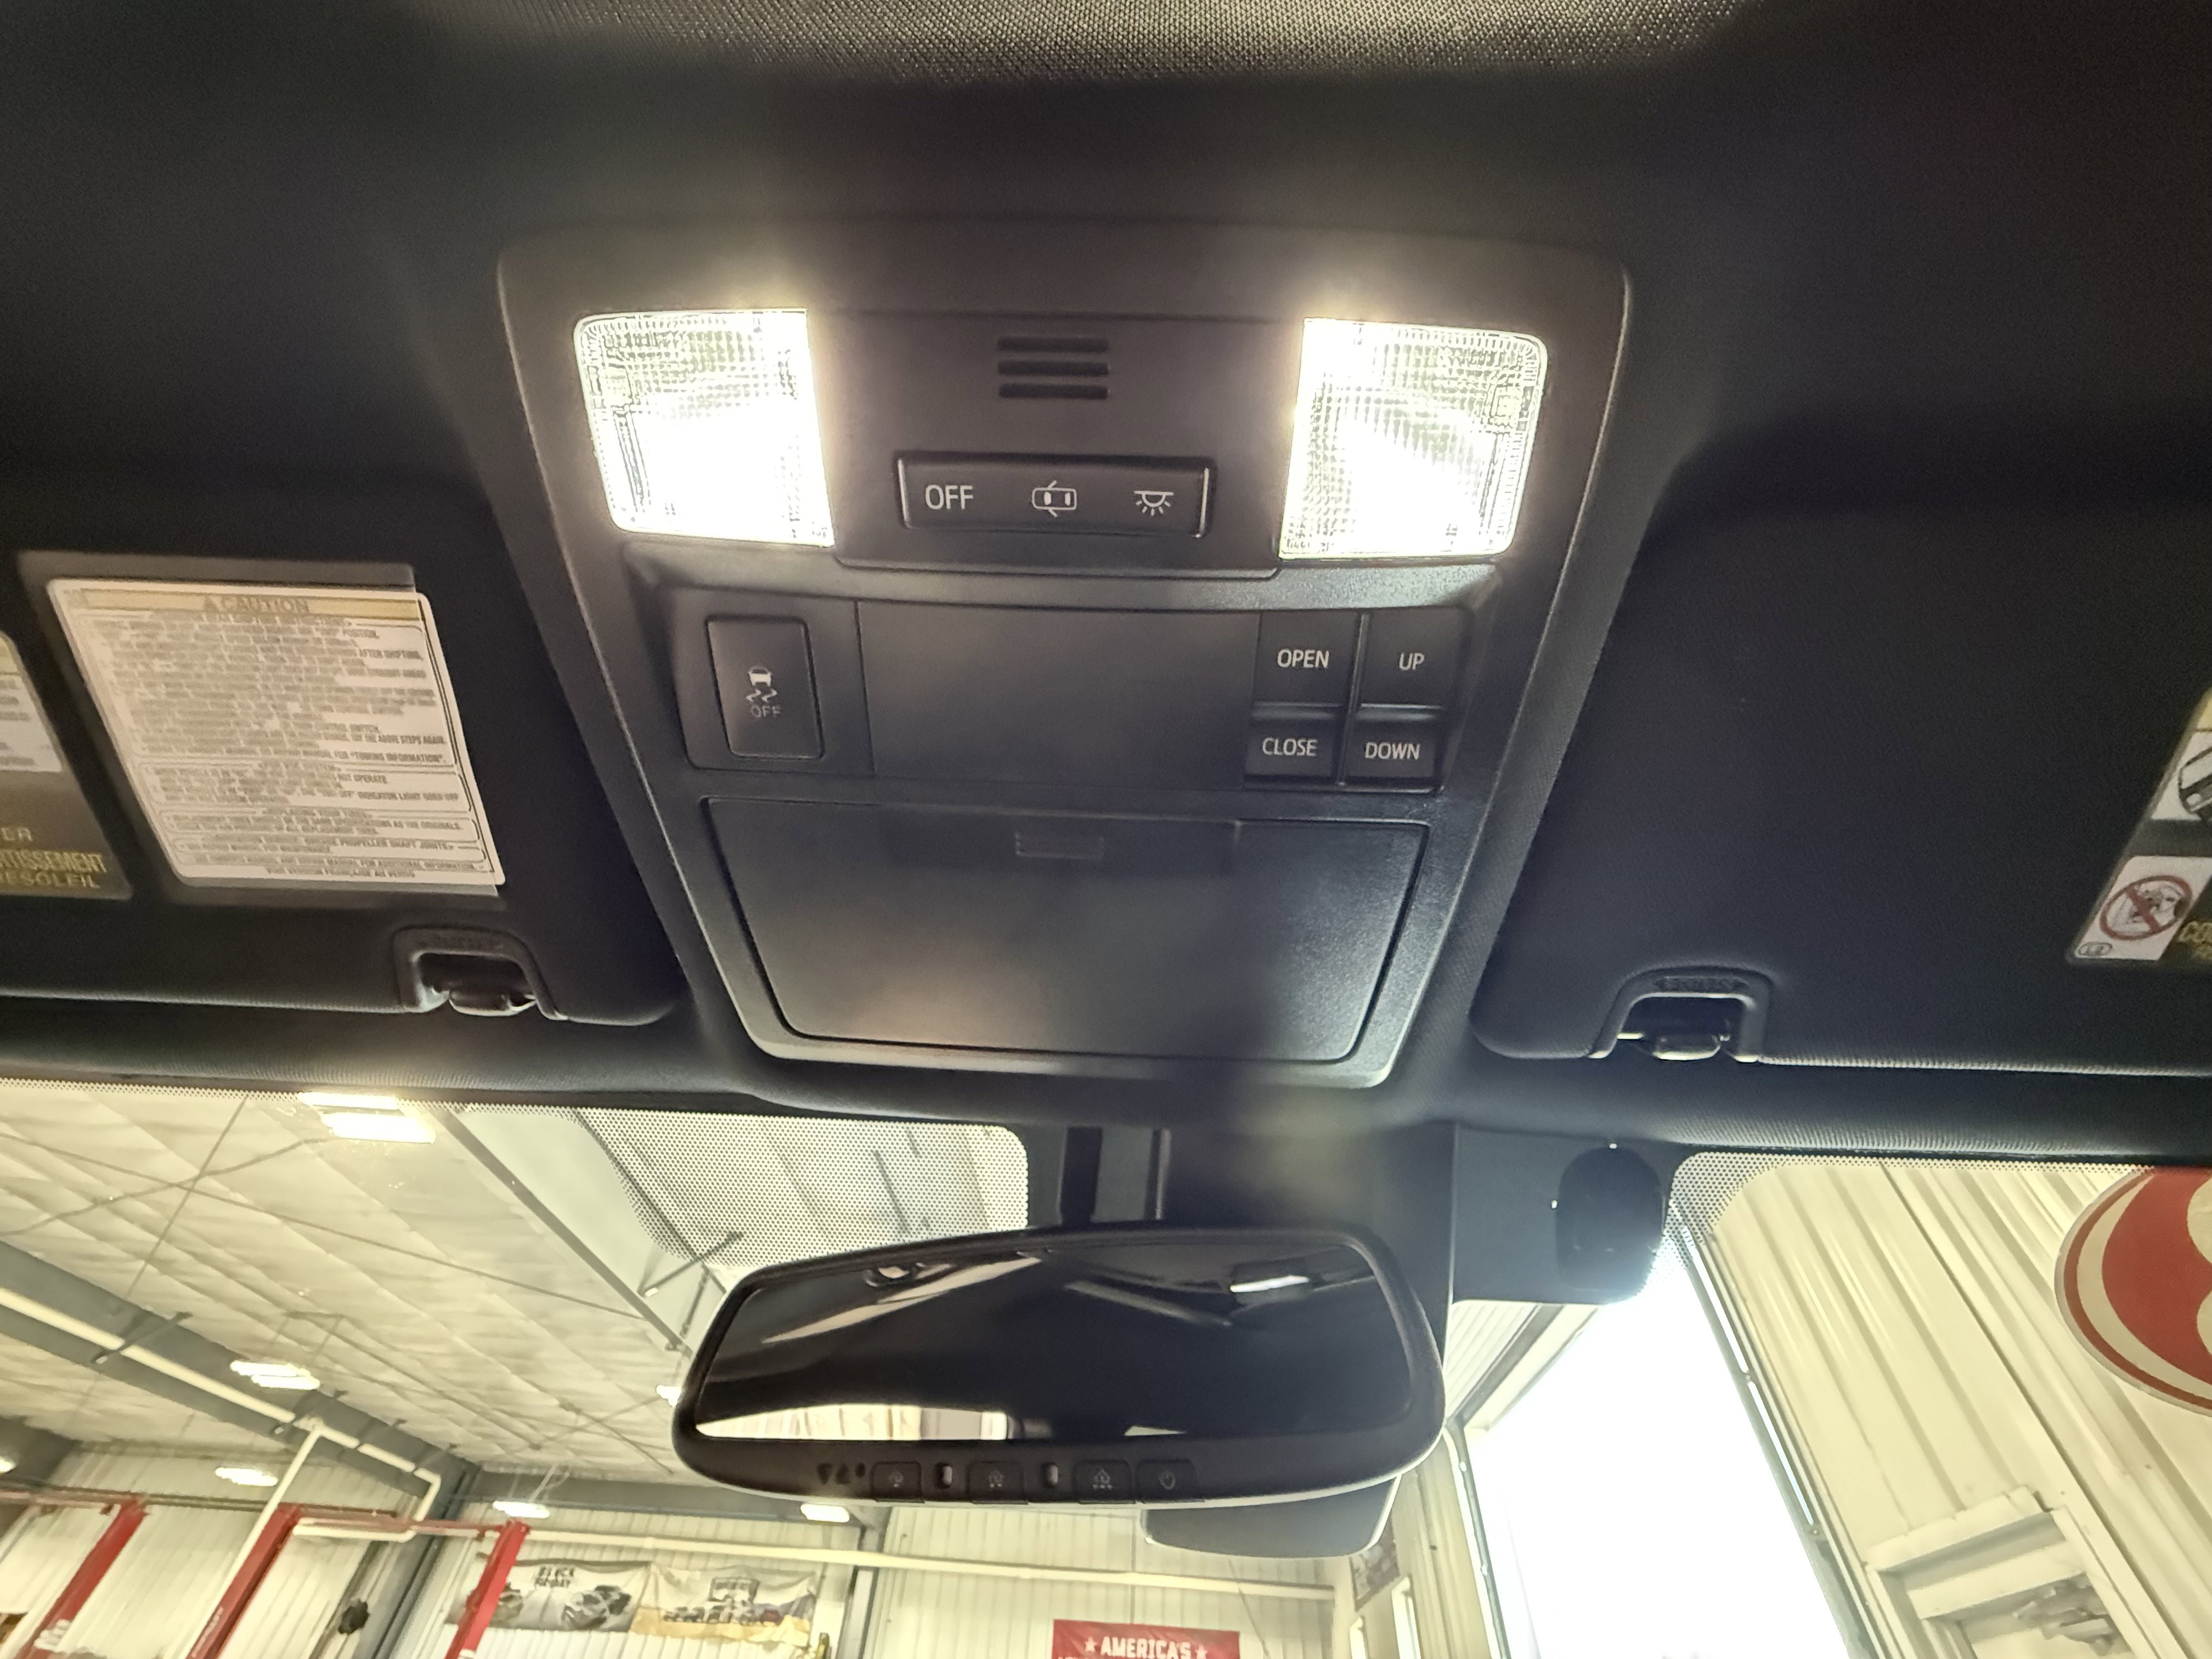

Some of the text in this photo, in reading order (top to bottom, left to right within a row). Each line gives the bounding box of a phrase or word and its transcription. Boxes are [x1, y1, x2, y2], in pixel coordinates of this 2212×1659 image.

[924, 485, 974, 510] OFF
[221, 595, 309, 613] CAUTION
[1277, 648, 1330, 669] OPEN
[1398, 652, 1425, 671] UP
[750, 704, 781, 719] OFF
[1261, 737, 1318, 757] CLOSE
[1364, 741, 1421, 761] DOWN
